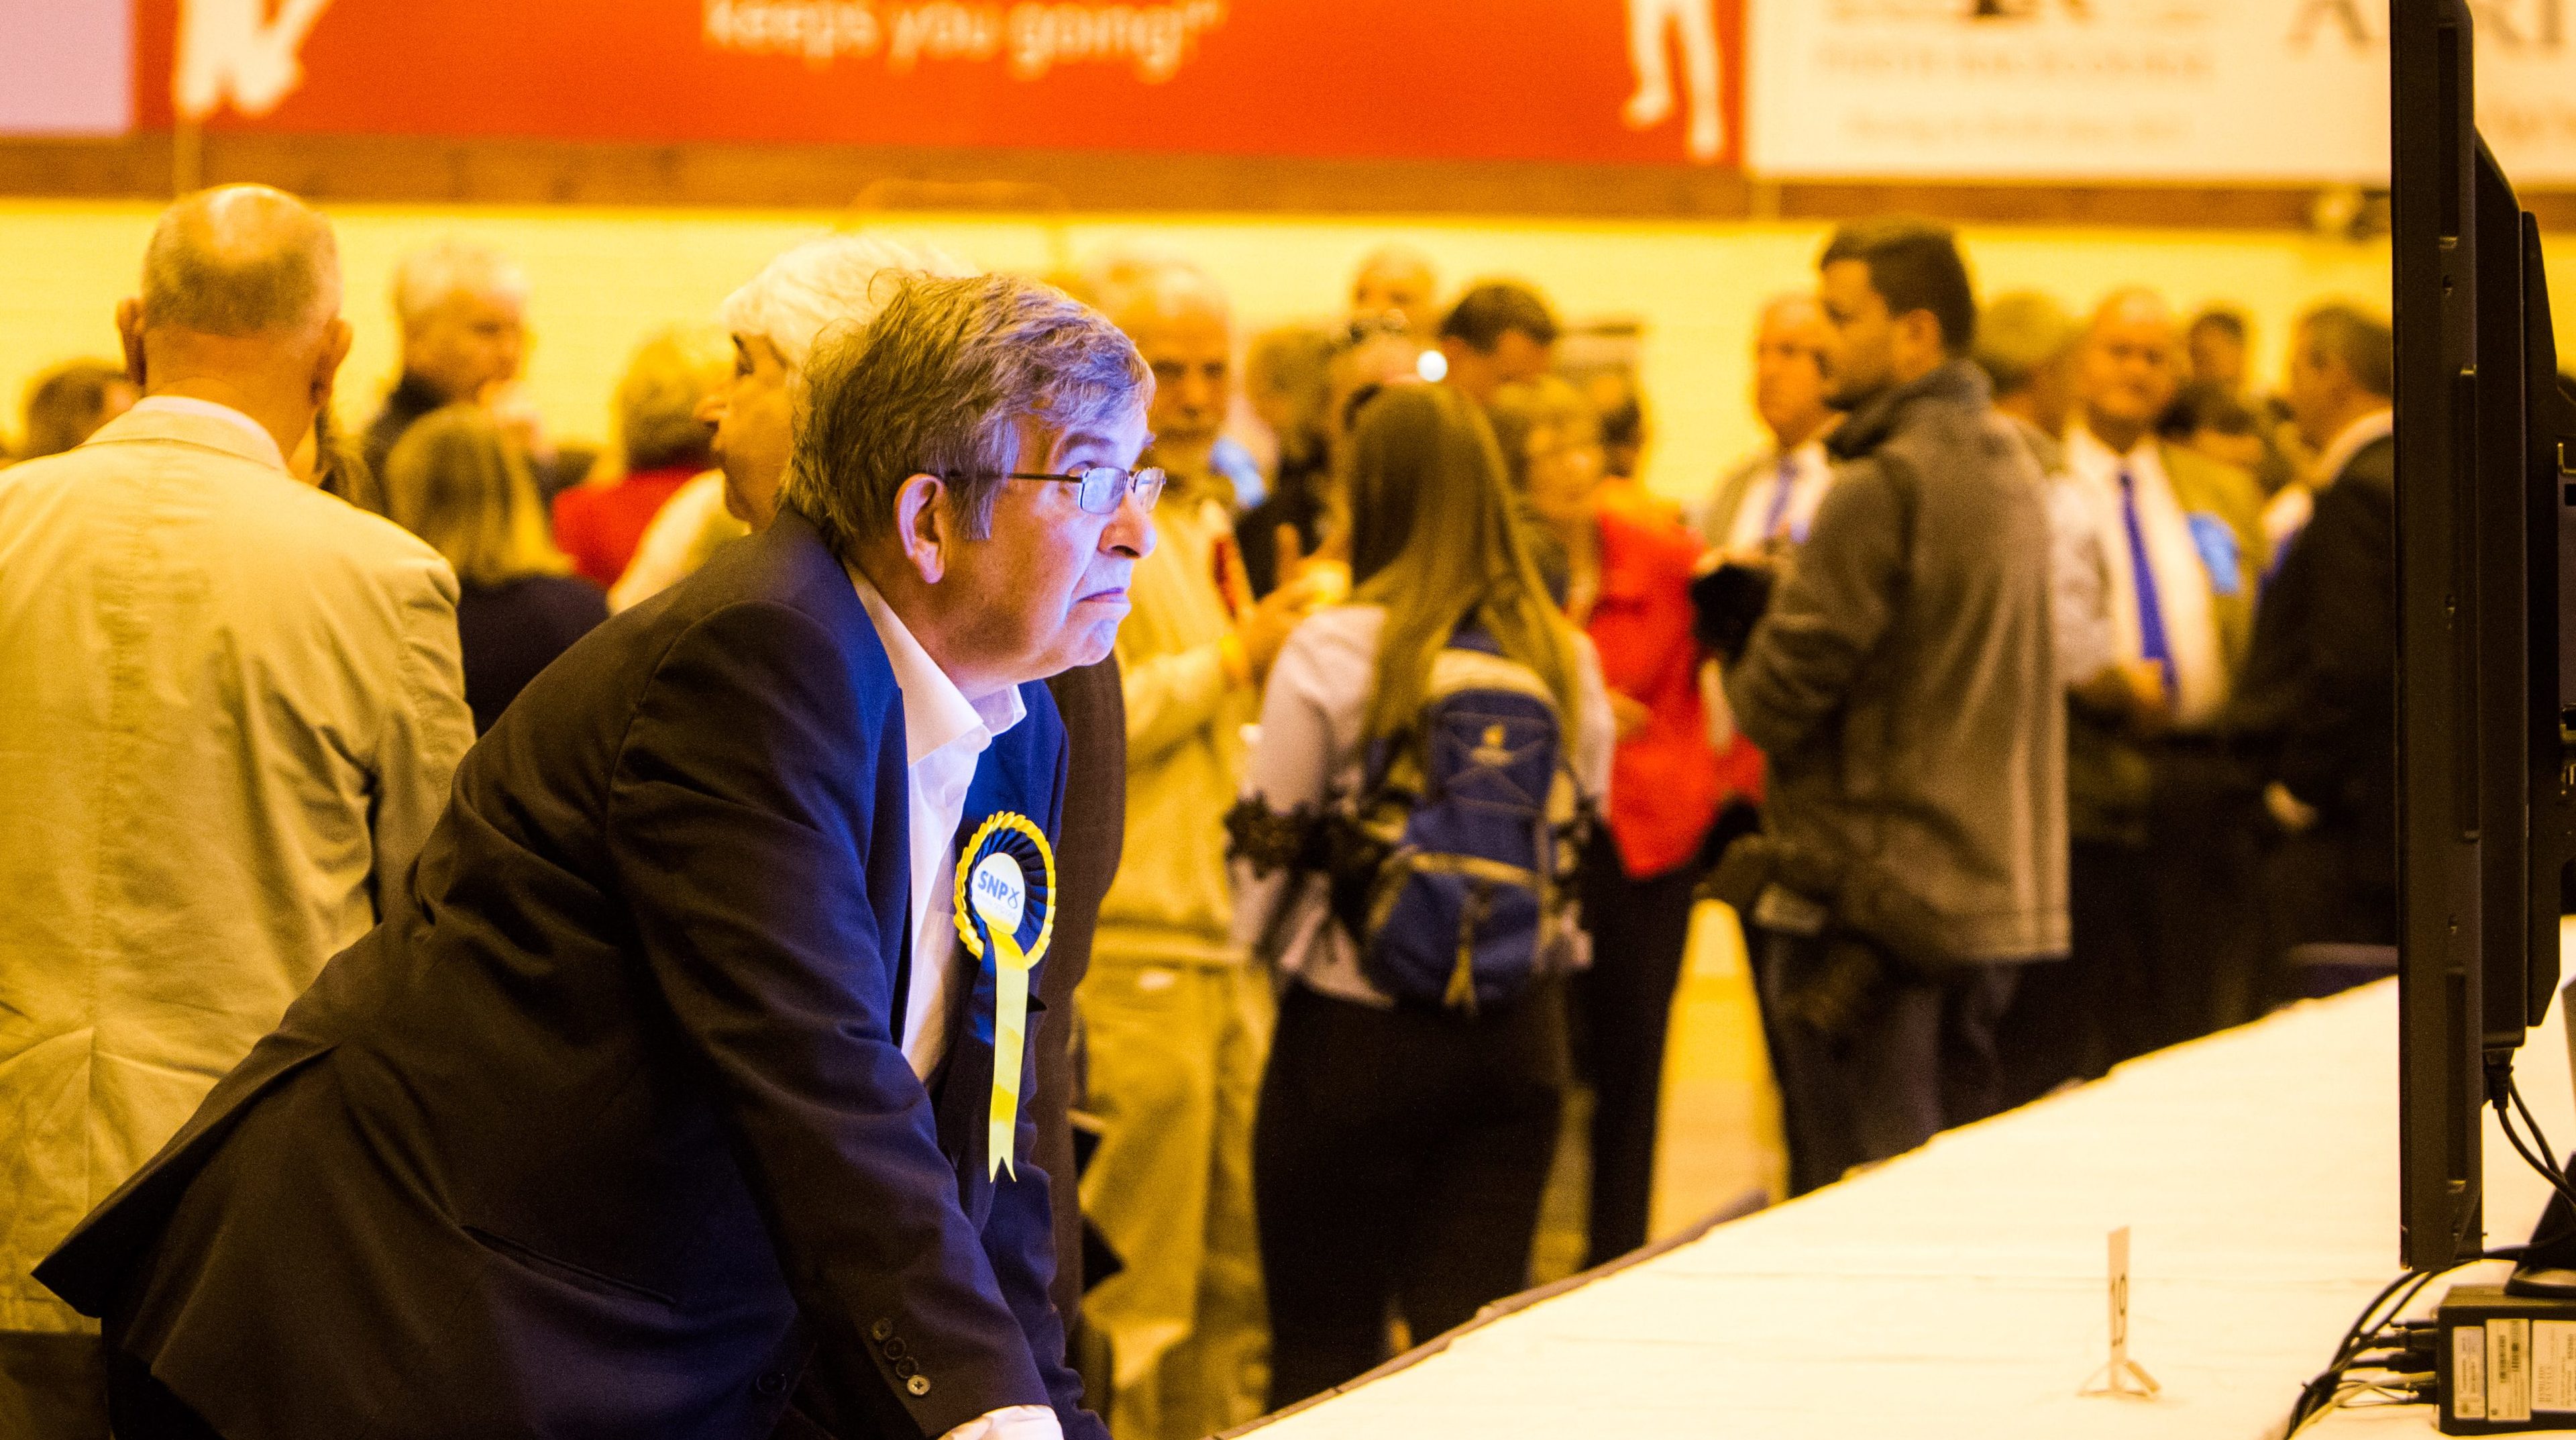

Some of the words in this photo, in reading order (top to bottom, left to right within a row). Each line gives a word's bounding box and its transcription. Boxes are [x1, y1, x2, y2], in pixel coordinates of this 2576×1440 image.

[704, 0, 877, 66] keeps
[888, 0, 1004, 70] you
[978, 870, 1008, 901] SNP
